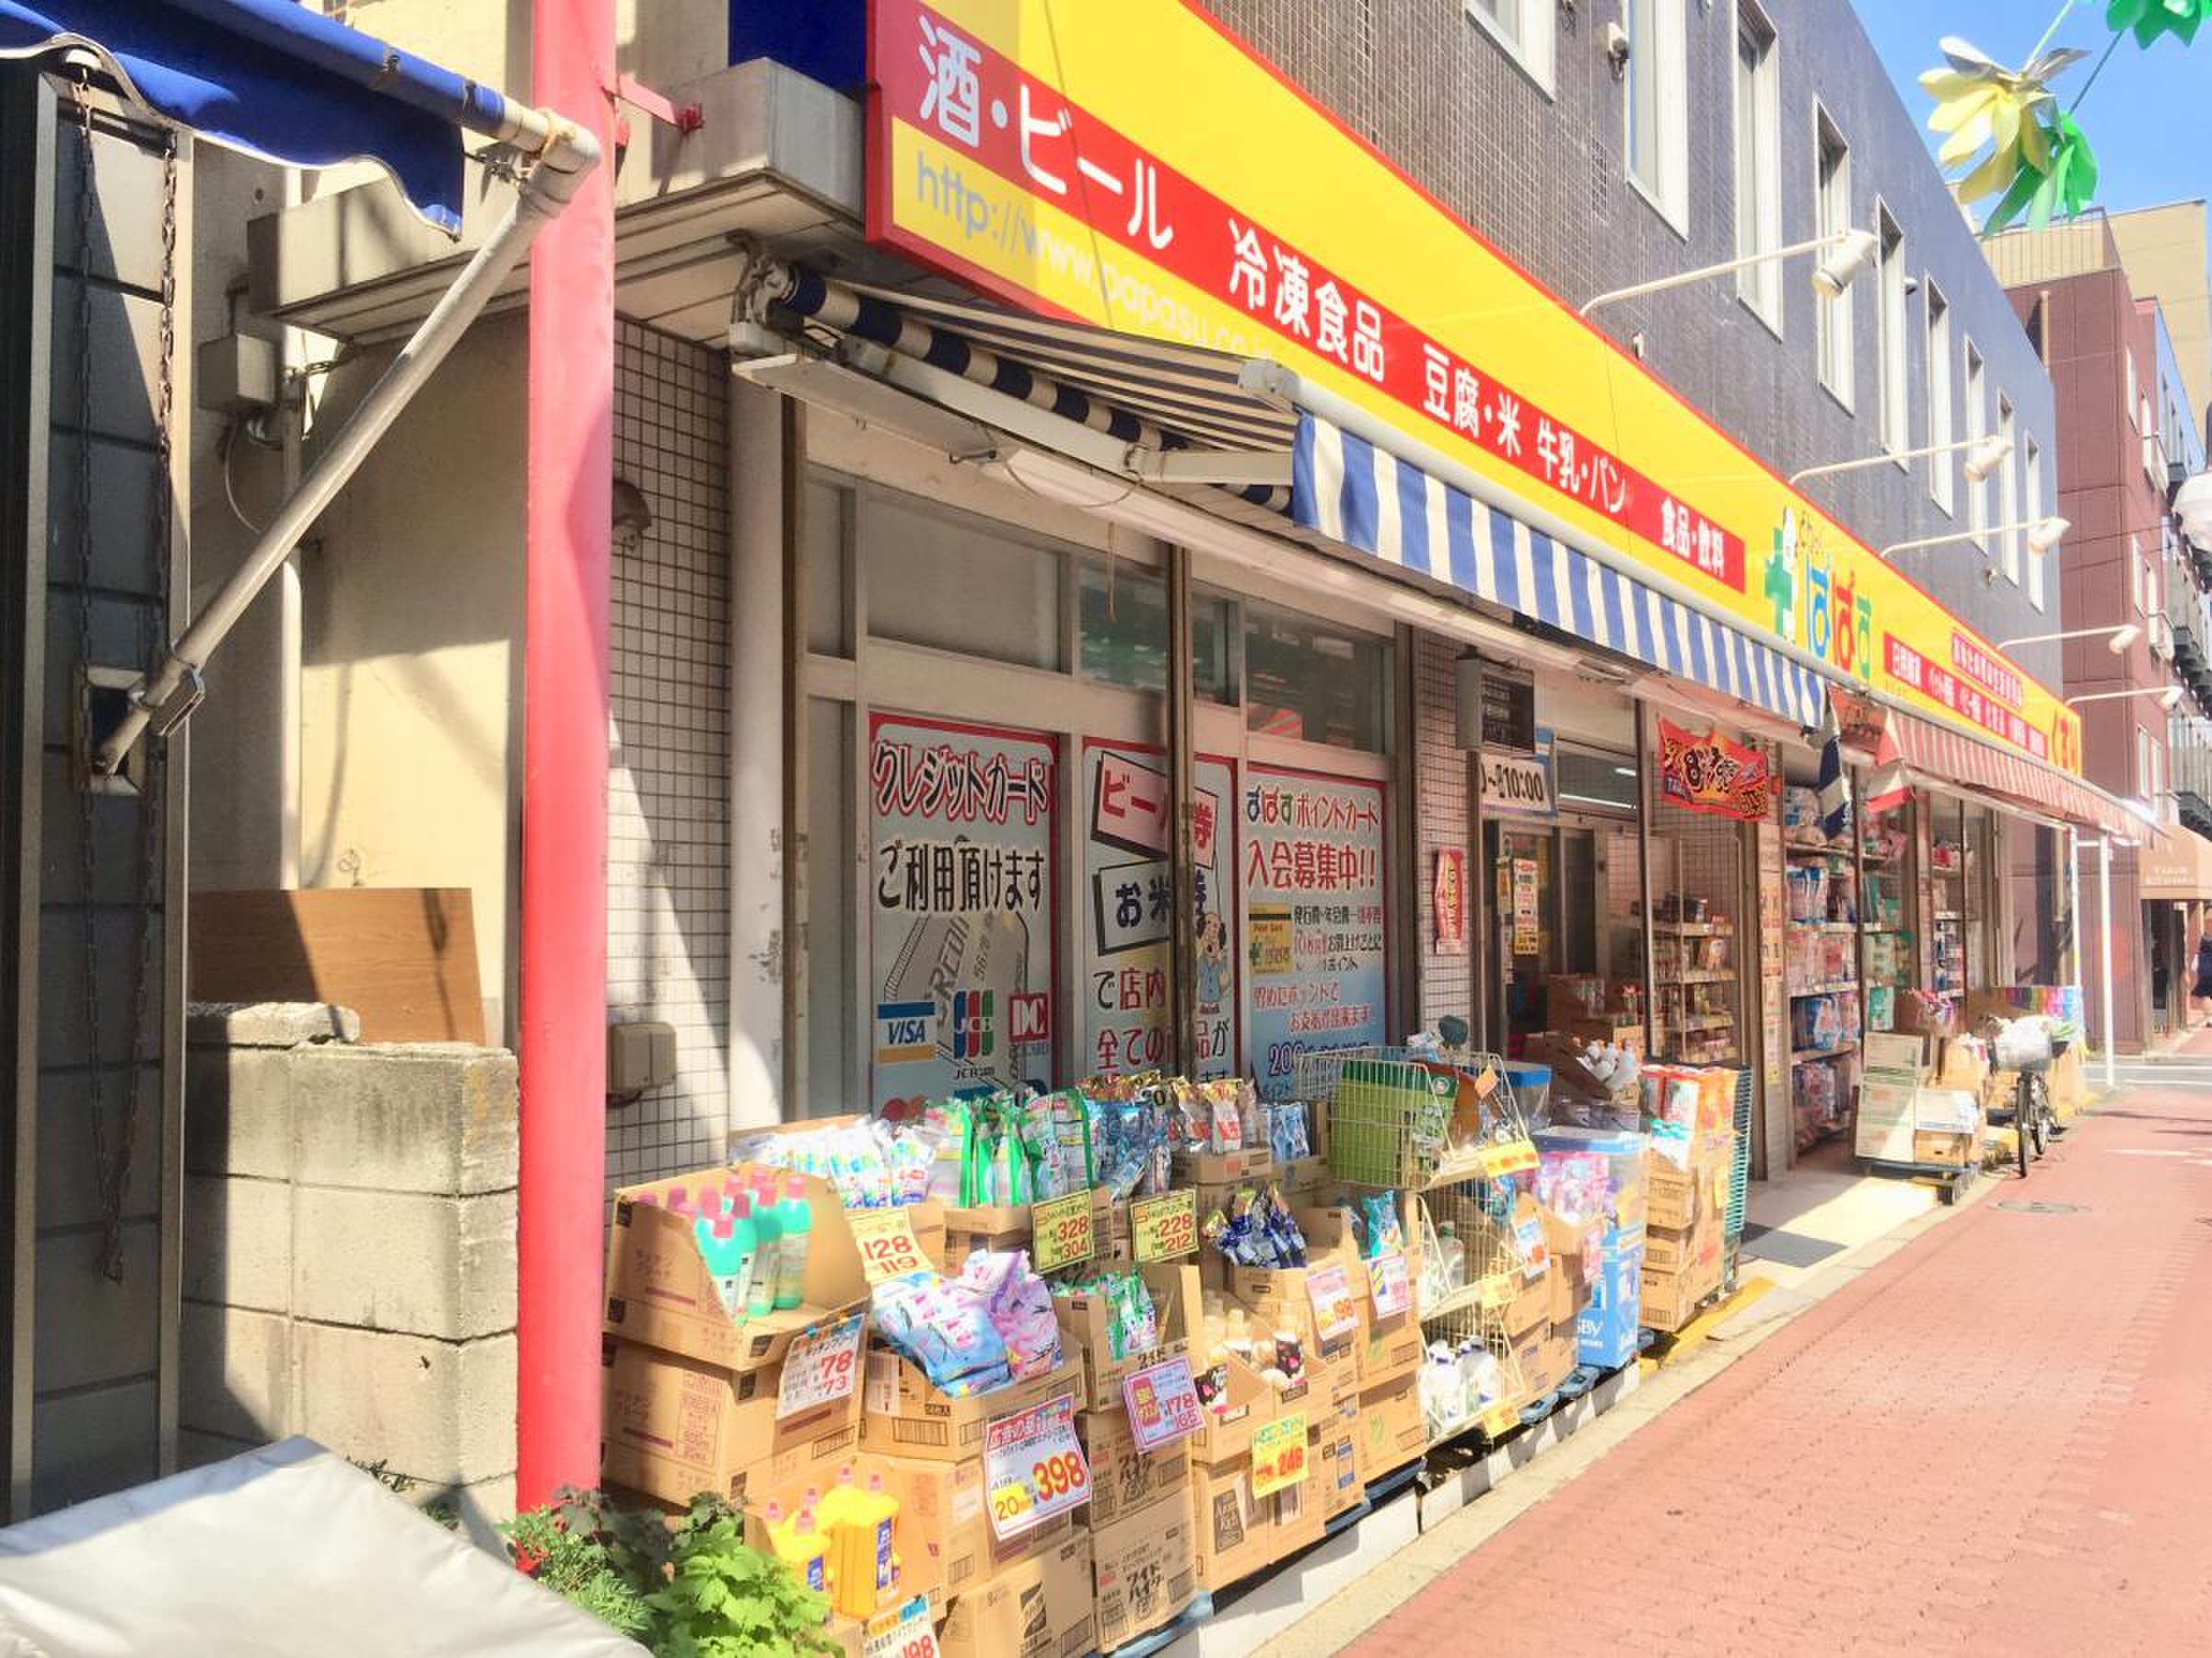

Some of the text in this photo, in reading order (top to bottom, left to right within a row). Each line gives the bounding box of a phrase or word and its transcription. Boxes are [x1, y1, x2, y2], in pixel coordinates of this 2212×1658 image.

[919, 15, 1173, 250] 酒・ビール
[1228, 218, 1384, 382] 冷凍食品
[1424, 343, 1521, 457] 豆腐・米
[1536, 418, 1626, 513] 牛乳・パン
[873, 741, 1048, 823] クレジットカード
[879, 840, 1045, 911] ご利用頂けます
[1248, 839, 1375, 890] 入会募集中!!
[888, 1020, 926, 1045] VISA
[1059, 1214, 1089, 1240] 328
[1159, 1212, 1193, 1238] 228
[864, 1235, 913, 1261] 128
[879, 1255, 919, 1273] 119
[821, 1349, 856, 1379] 78
[1031, 1451, 1086, 1501] 398
